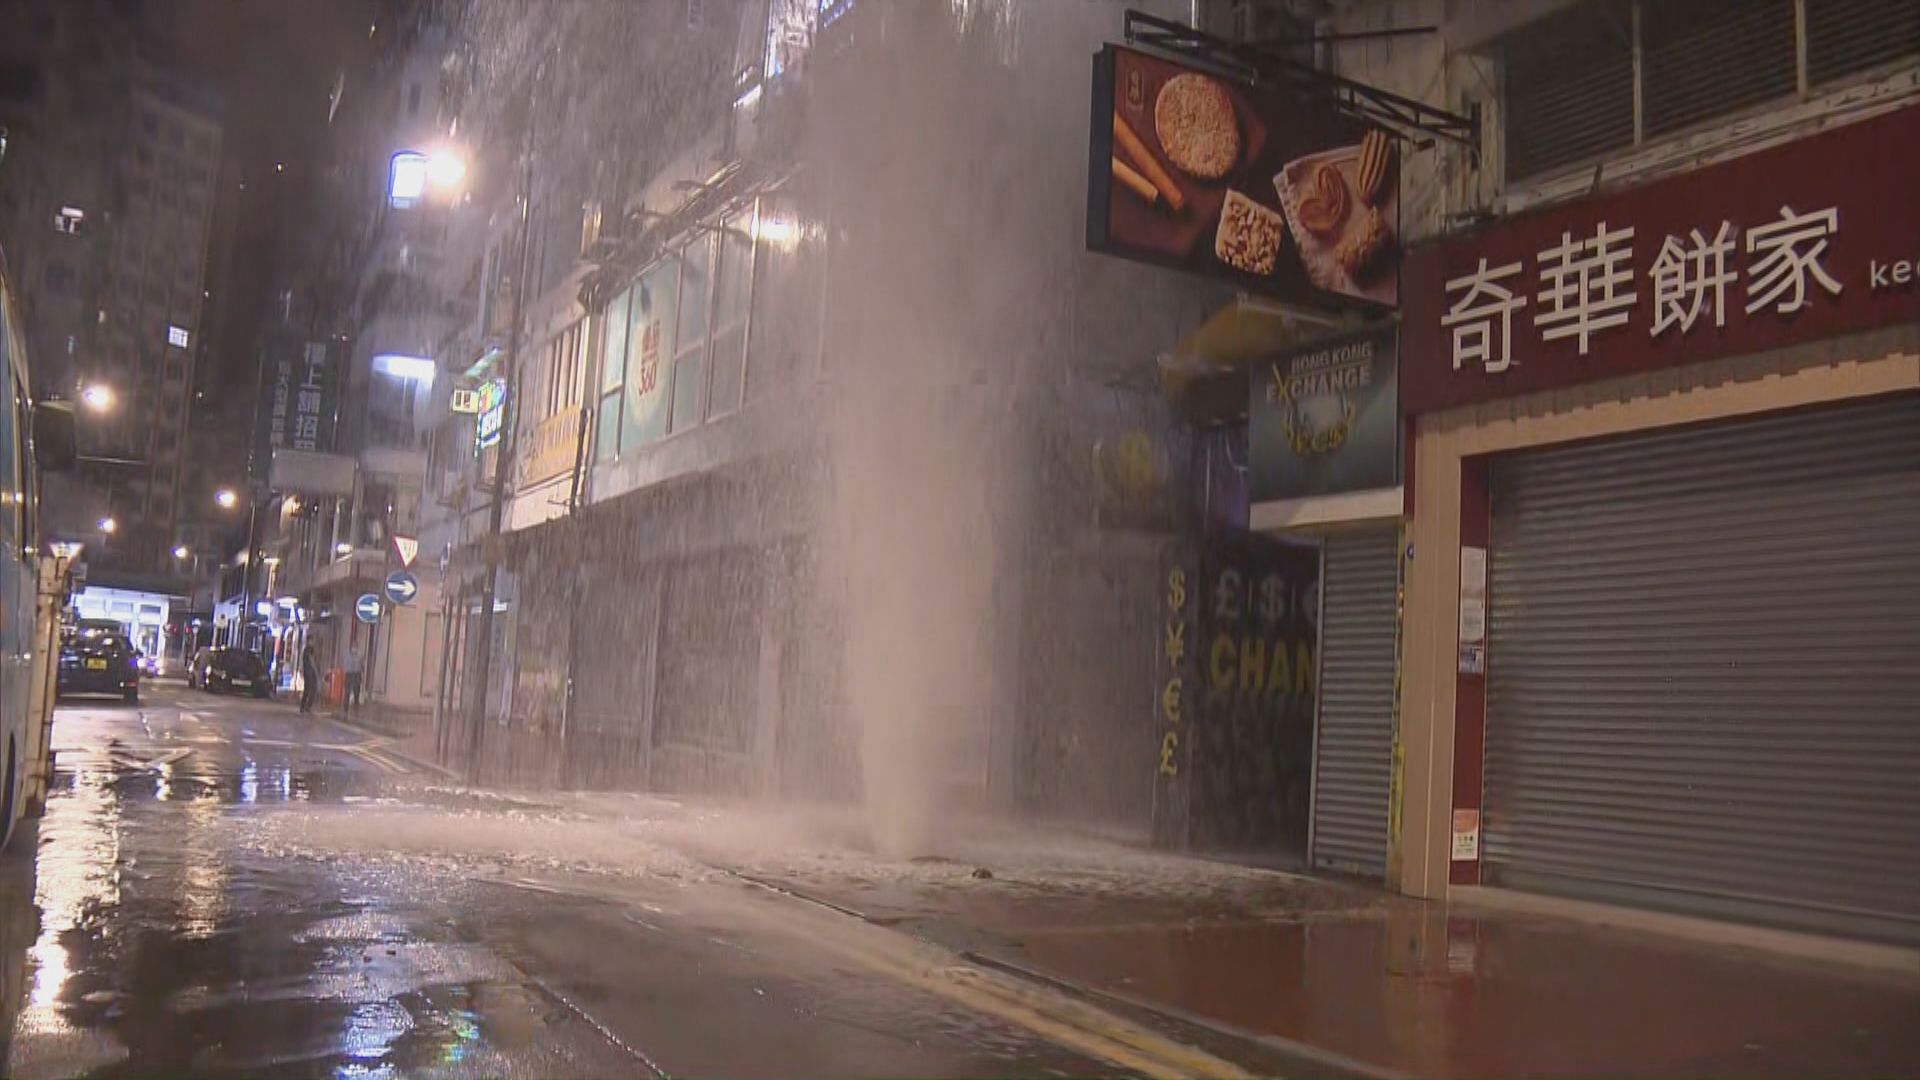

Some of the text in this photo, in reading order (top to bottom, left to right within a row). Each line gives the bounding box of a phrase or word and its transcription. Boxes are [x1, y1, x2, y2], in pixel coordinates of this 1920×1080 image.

[1440, 205, 1845, 374] 奇華餅家
[1870, 258, 1920, 290] ke
[1290, 341, 1372, 374] HONG KONG
[1266, 363, 1372, 405] EXCHANGE
[1211, 632, 1317, 695] CHAN
